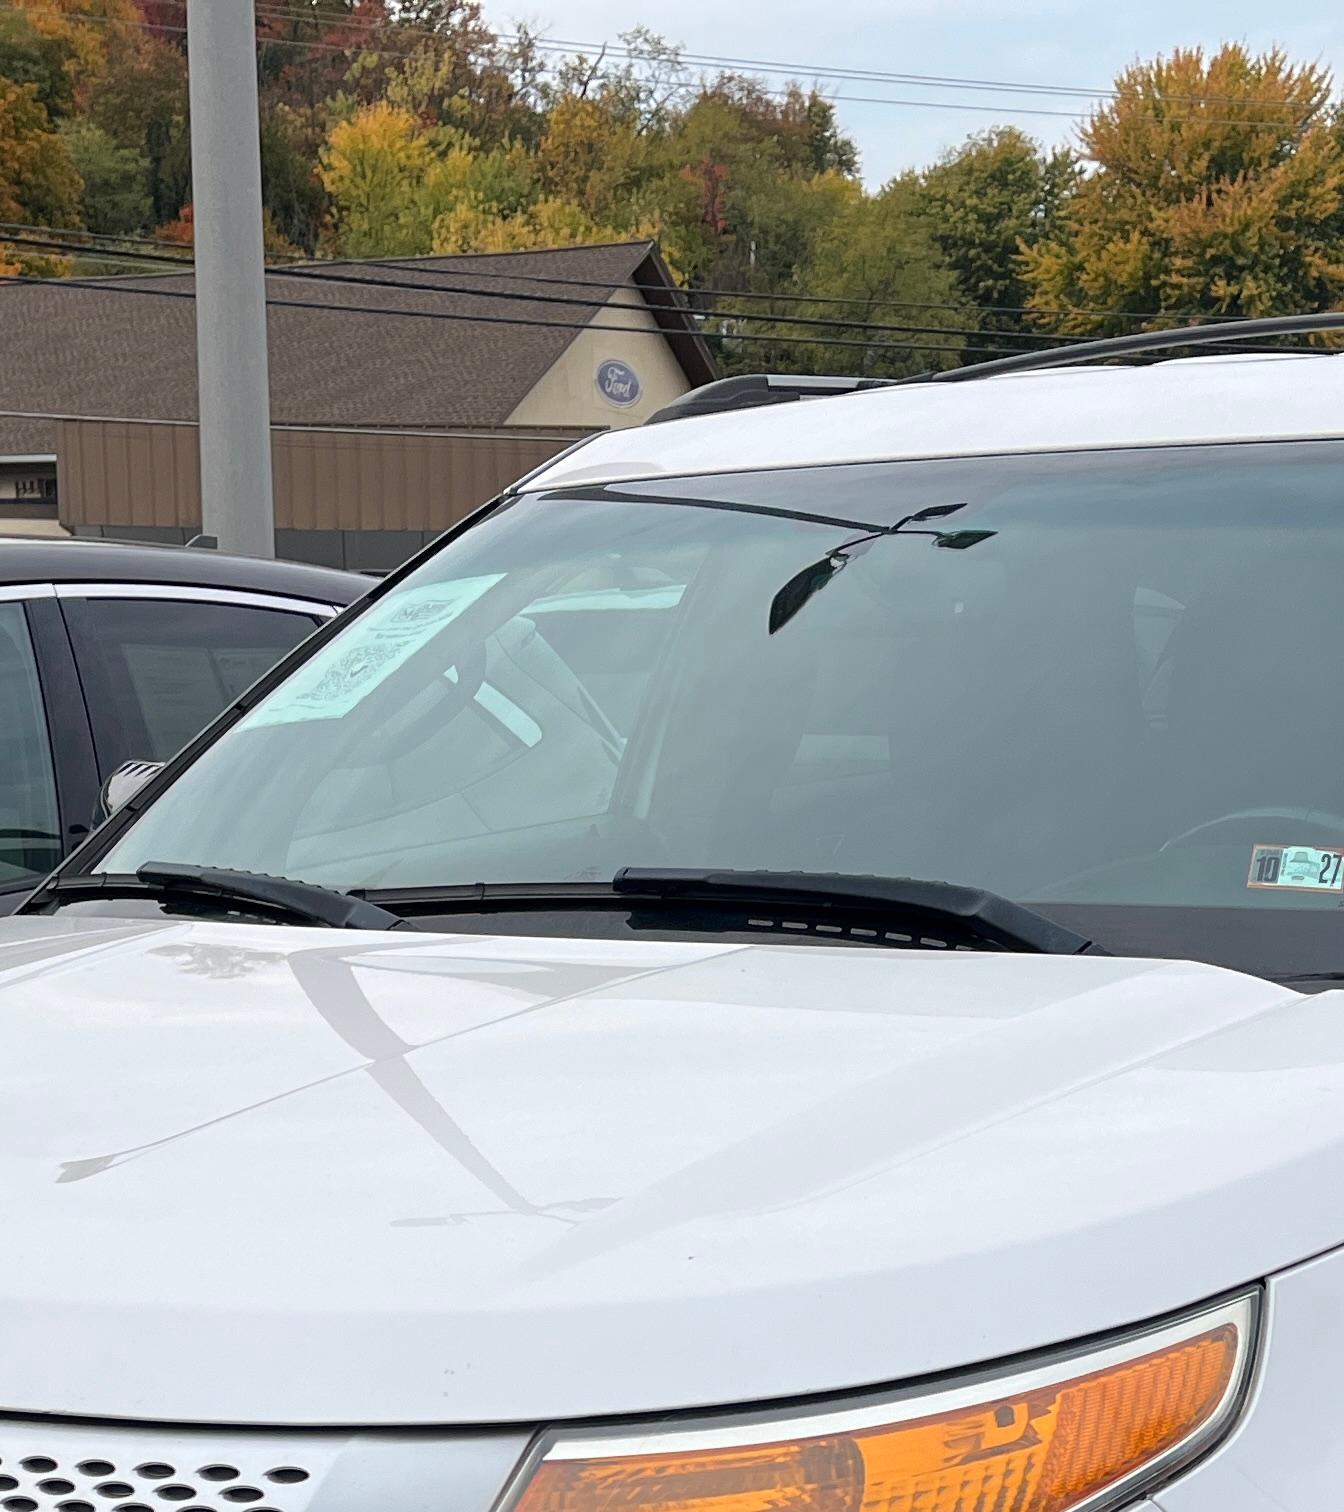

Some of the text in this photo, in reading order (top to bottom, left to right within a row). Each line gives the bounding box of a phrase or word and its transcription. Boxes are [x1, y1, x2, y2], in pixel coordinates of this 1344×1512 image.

[604, 366, 632, 398] Ford
[1256, 856, 1280, 882] 10
[1318, 854, 1342, 884] 27
